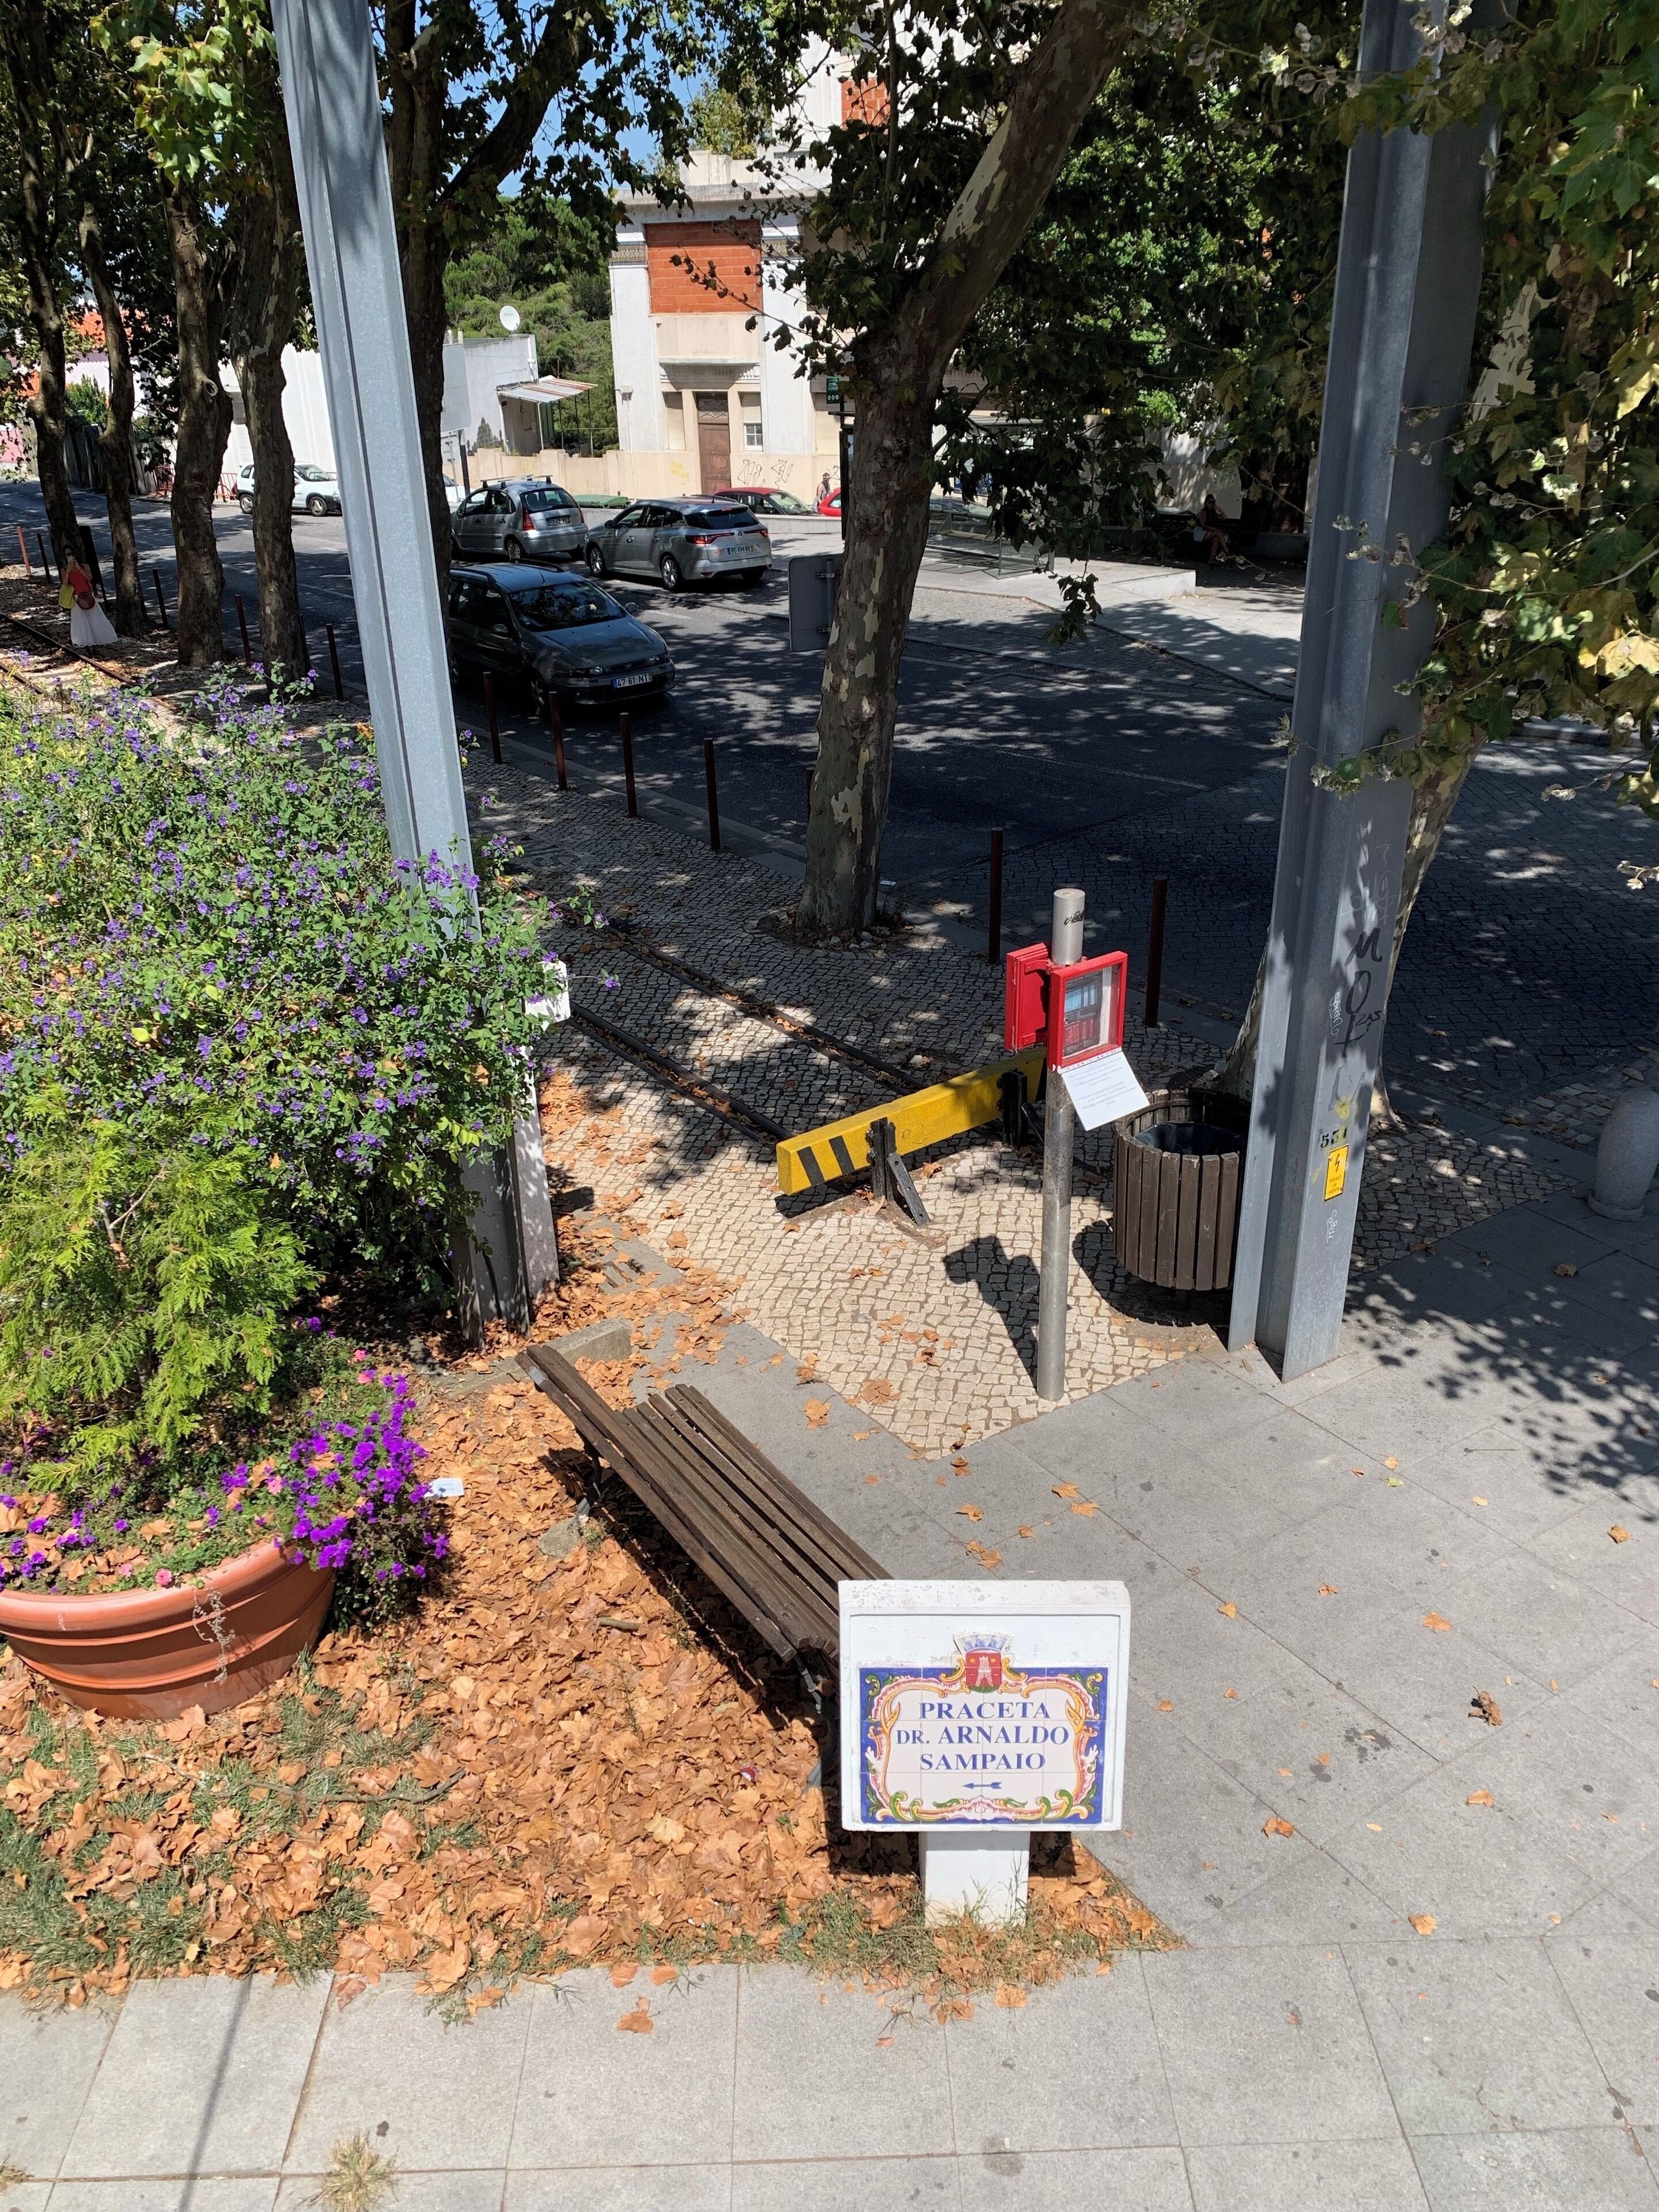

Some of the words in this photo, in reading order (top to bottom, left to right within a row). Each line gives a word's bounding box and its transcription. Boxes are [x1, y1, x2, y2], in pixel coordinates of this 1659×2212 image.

[918, 1702, 1050, 1719] PRACETA
[896, 1729, 930, 1745] DR.
[937, 1726, 1069, 1745] ARNALDO
[919, 1753, 1046, 1770] SAMPAIO
